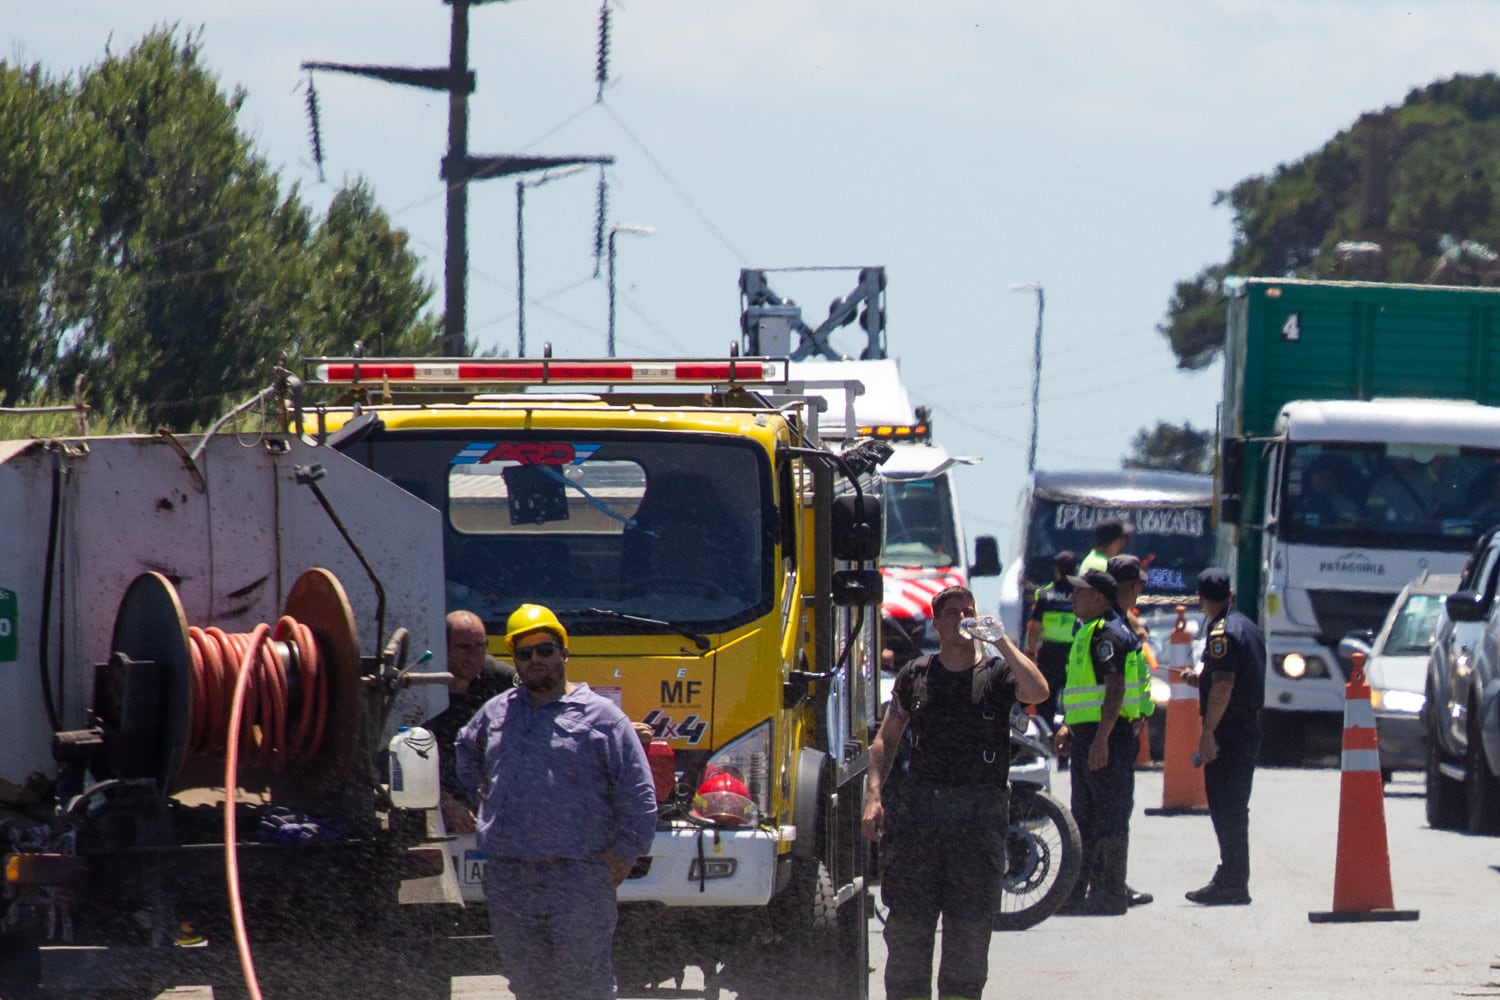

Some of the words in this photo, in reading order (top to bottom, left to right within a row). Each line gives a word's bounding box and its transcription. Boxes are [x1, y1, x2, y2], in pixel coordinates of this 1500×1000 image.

[1282, 312, 1300, 340] 4
[661, 680, 702, 704] MF
[641, 709, 709, 745] 4x4
